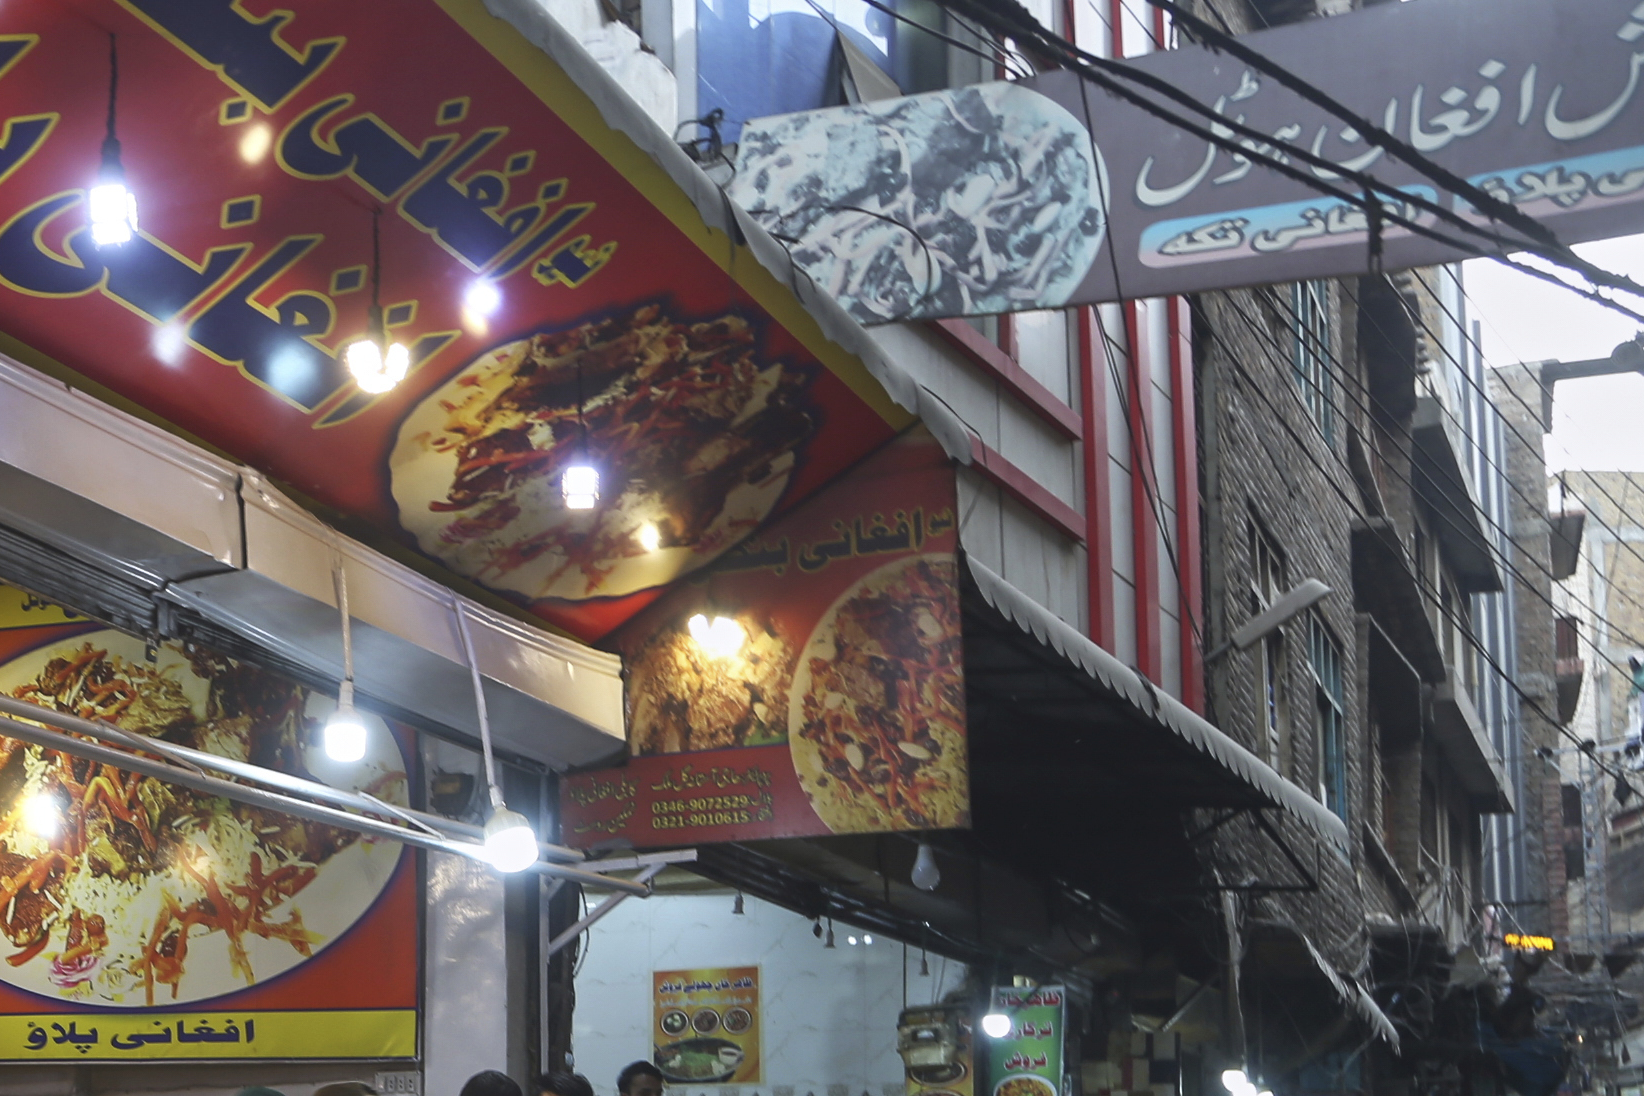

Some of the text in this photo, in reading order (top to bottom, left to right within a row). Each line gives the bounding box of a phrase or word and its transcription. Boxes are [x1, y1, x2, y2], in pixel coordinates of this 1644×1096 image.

[274, 92, 597, 286] افغانی
[797, 507, 924, 573] افغانی
[110, 1018, 255, 1050] افغانی
